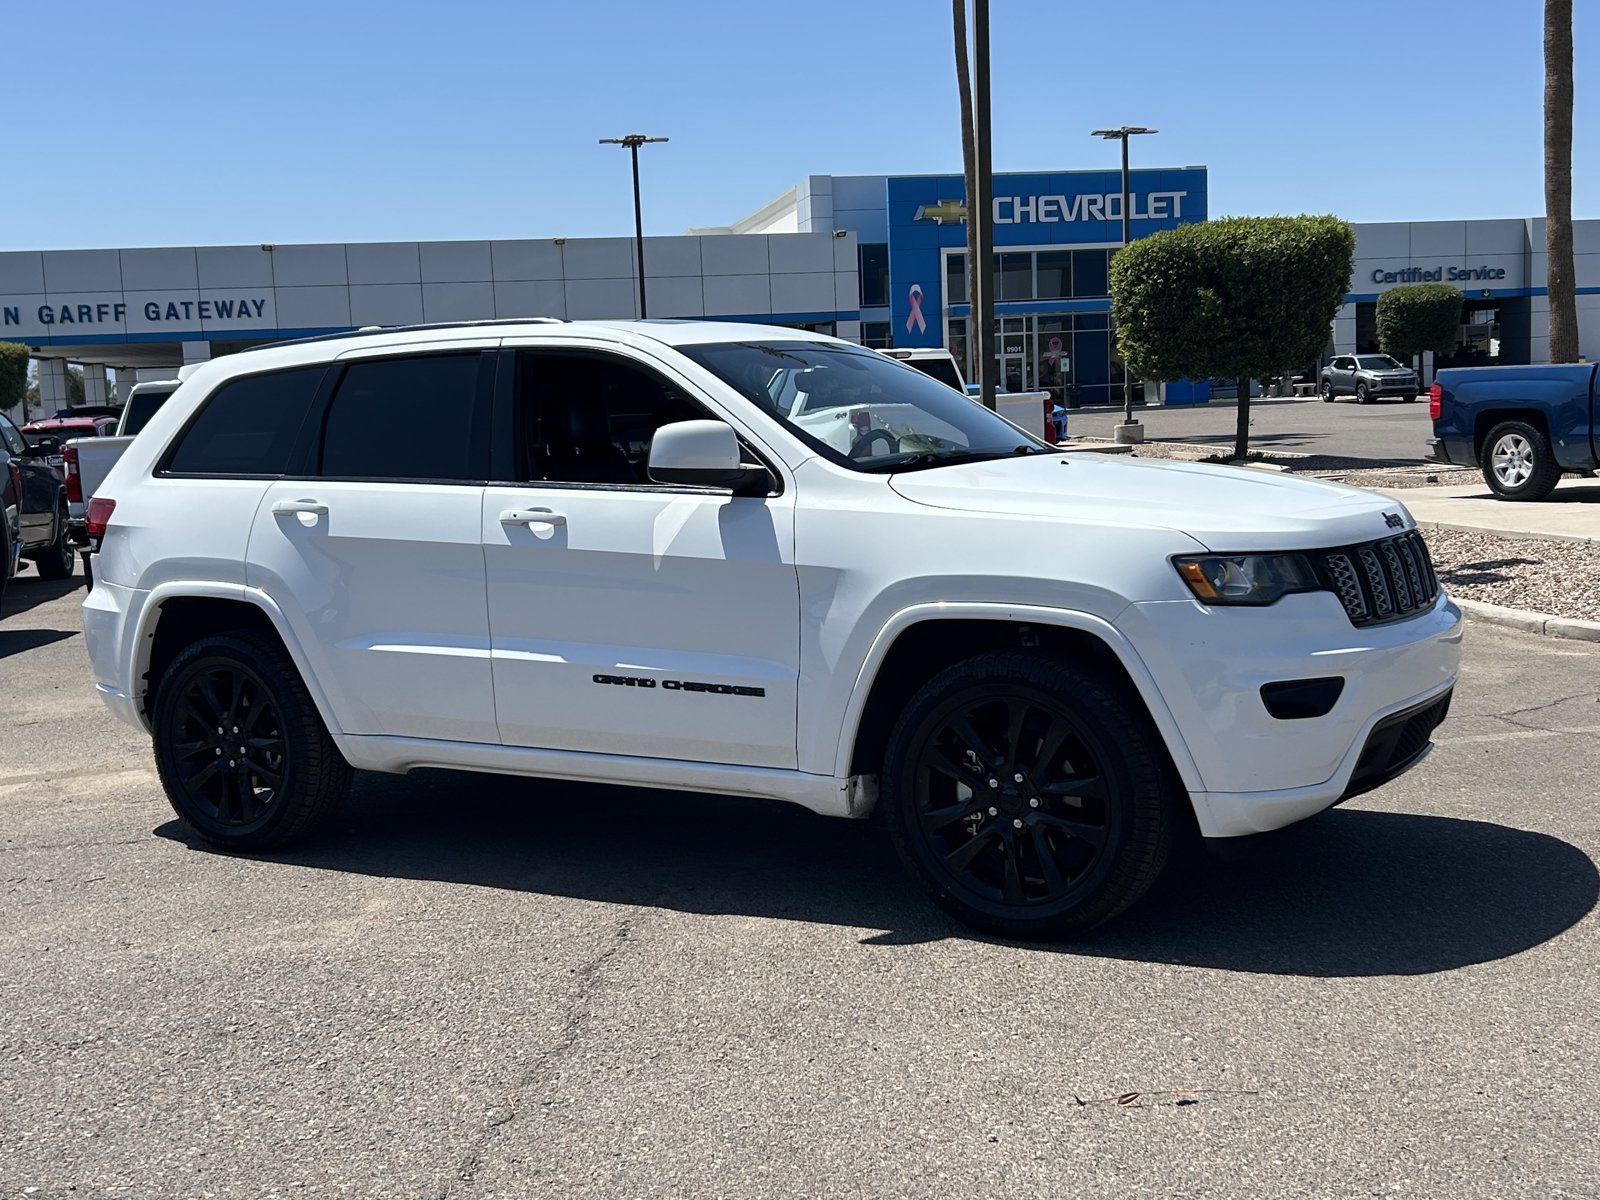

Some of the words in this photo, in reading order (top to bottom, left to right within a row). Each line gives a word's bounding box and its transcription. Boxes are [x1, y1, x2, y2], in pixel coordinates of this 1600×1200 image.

[992, 191, 1187, 224] CHEVROLET
[1373, 266, 1443, 284] Certified
[1448, 265, 1505, 281] Service
[38, 303, 127, 325] GARFF
[144, 299, 266, 321] GATEWAY
[594, 674, 656, 688] GRAND
[662, 681, 765, 697] CHEROKEE
